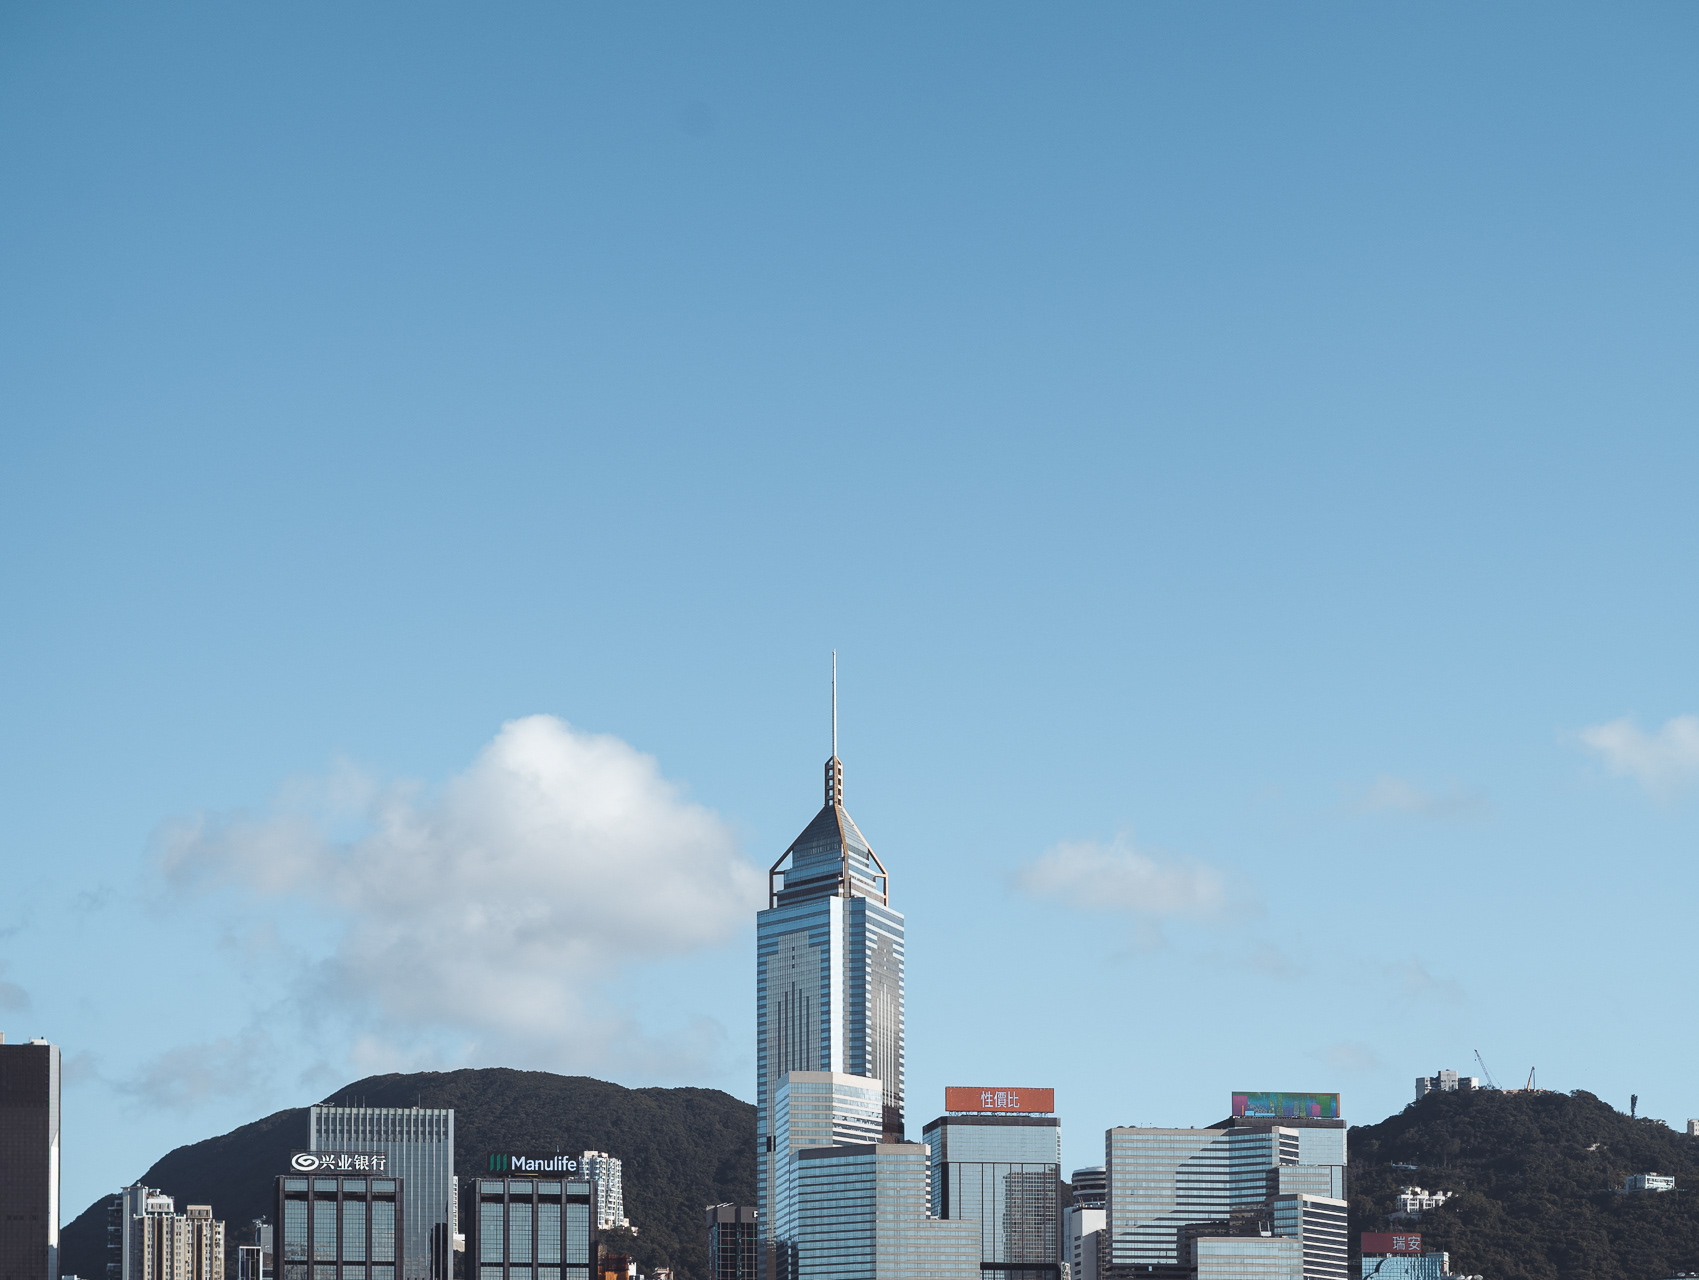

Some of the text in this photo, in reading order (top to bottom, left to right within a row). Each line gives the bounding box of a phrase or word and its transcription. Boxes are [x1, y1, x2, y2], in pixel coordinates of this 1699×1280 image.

[981, 1091, 1020, 1108] 性價比
[320, 1154, 386, 1170] 兴业银行
[511, 1156, 577, 1171] Manulife
[1393, 1236, 1420, 1250] 瑞安
